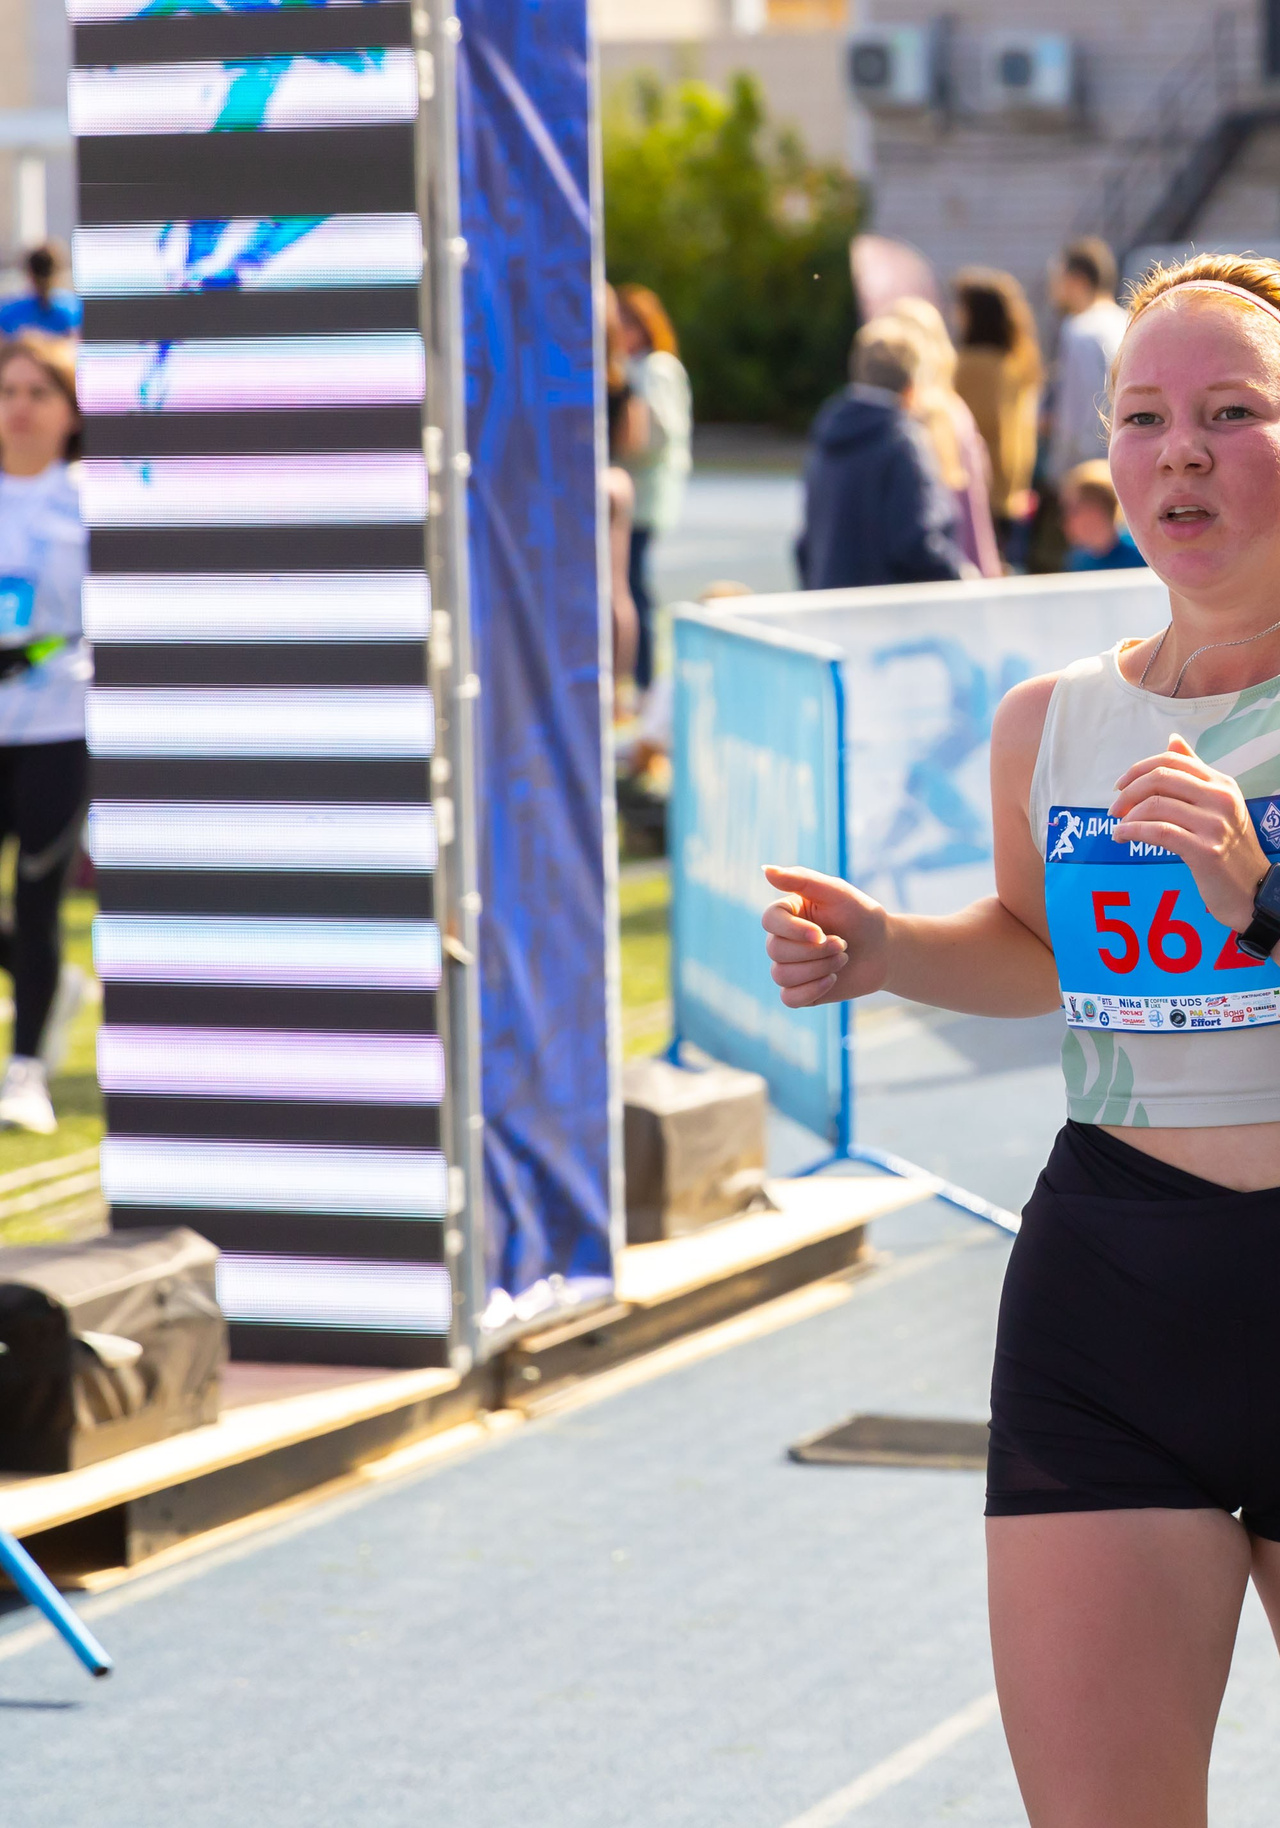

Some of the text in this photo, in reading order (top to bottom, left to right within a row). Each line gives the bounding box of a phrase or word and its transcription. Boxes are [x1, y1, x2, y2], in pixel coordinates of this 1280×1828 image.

[1129, 839, 1177, 857] МИЛ
[1119, 998, 1141, 1008] Nika
[1179, 997, 1202, 1007] UDS
[1191, 1018, 1221, 1027] Effort
